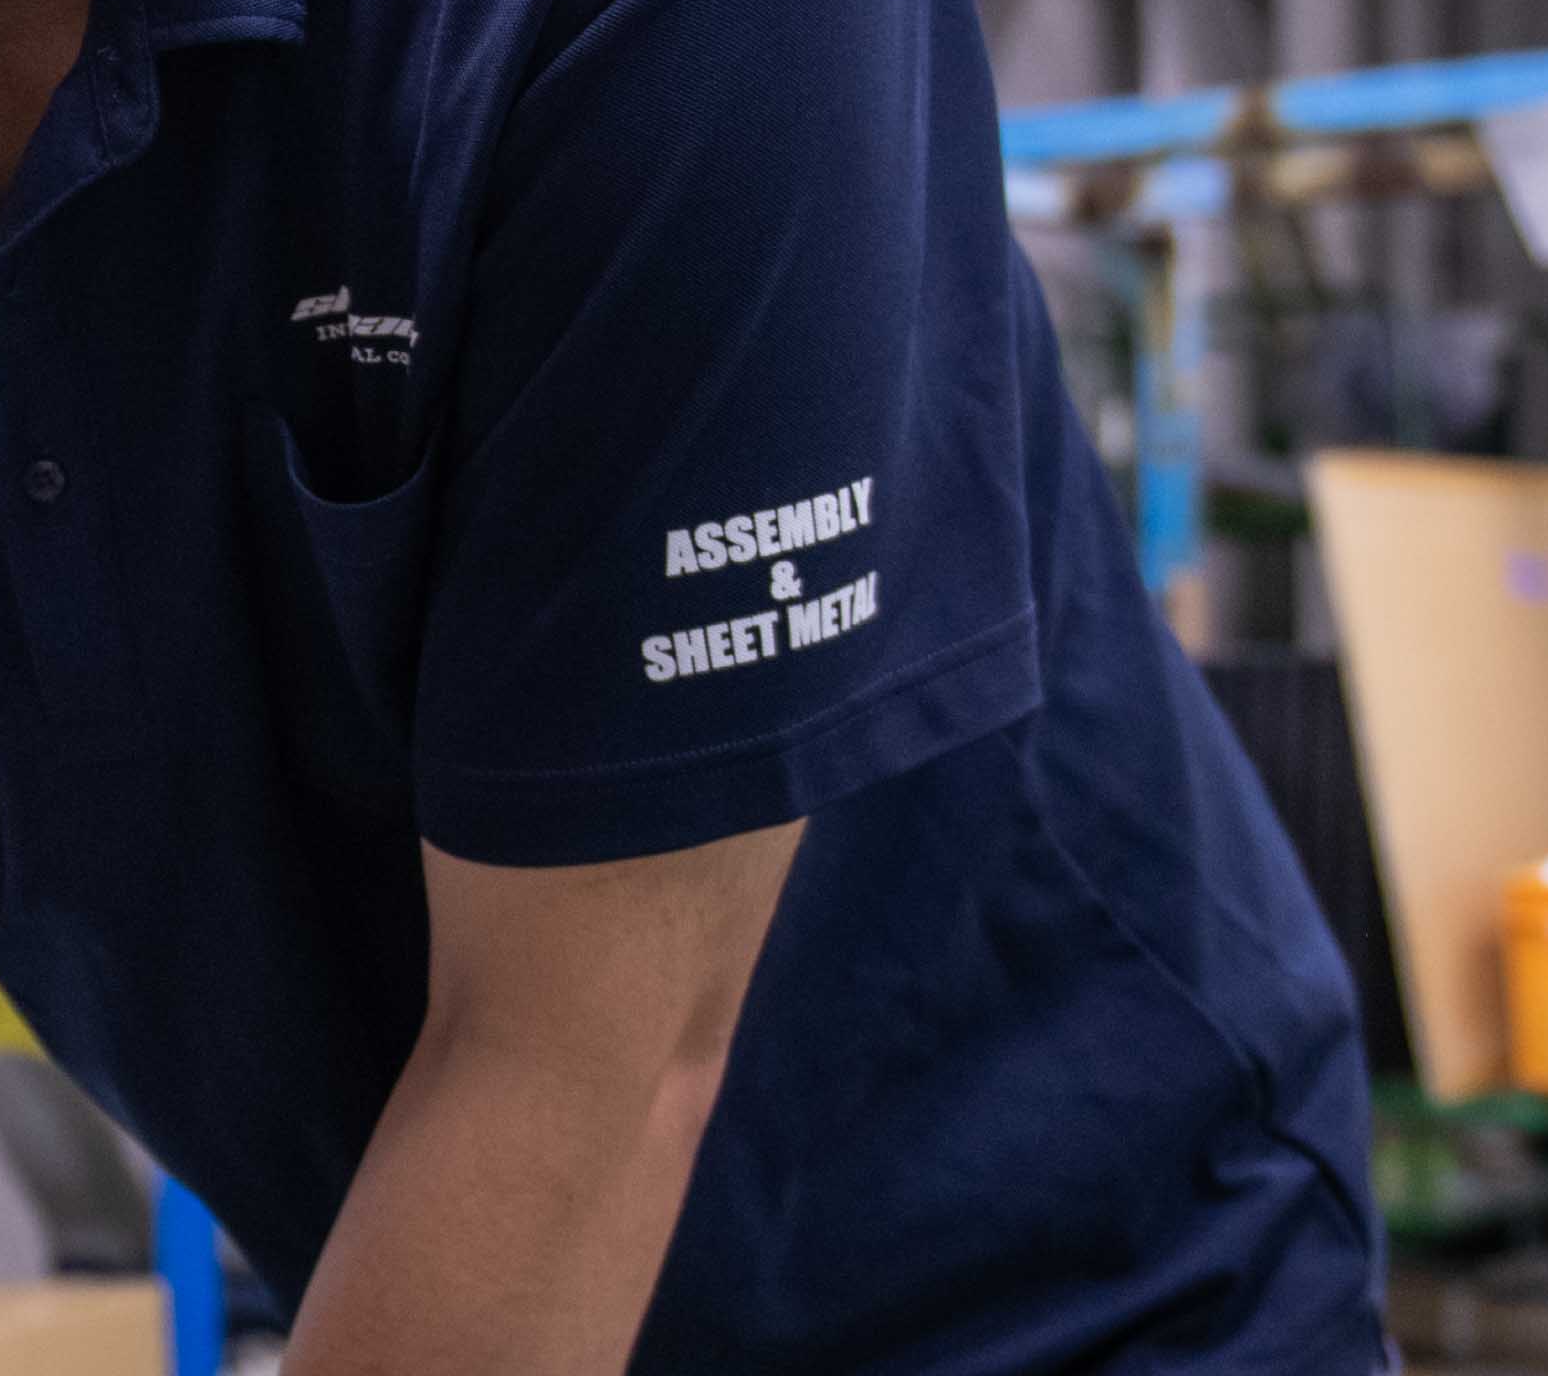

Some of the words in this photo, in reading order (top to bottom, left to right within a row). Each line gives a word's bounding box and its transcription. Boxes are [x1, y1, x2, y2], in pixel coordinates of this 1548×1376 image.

[665, 477, 873, 577] ASSEMBLY
[770, 560, 802, 601] &
[641, 610, 780, 682] SHEET
